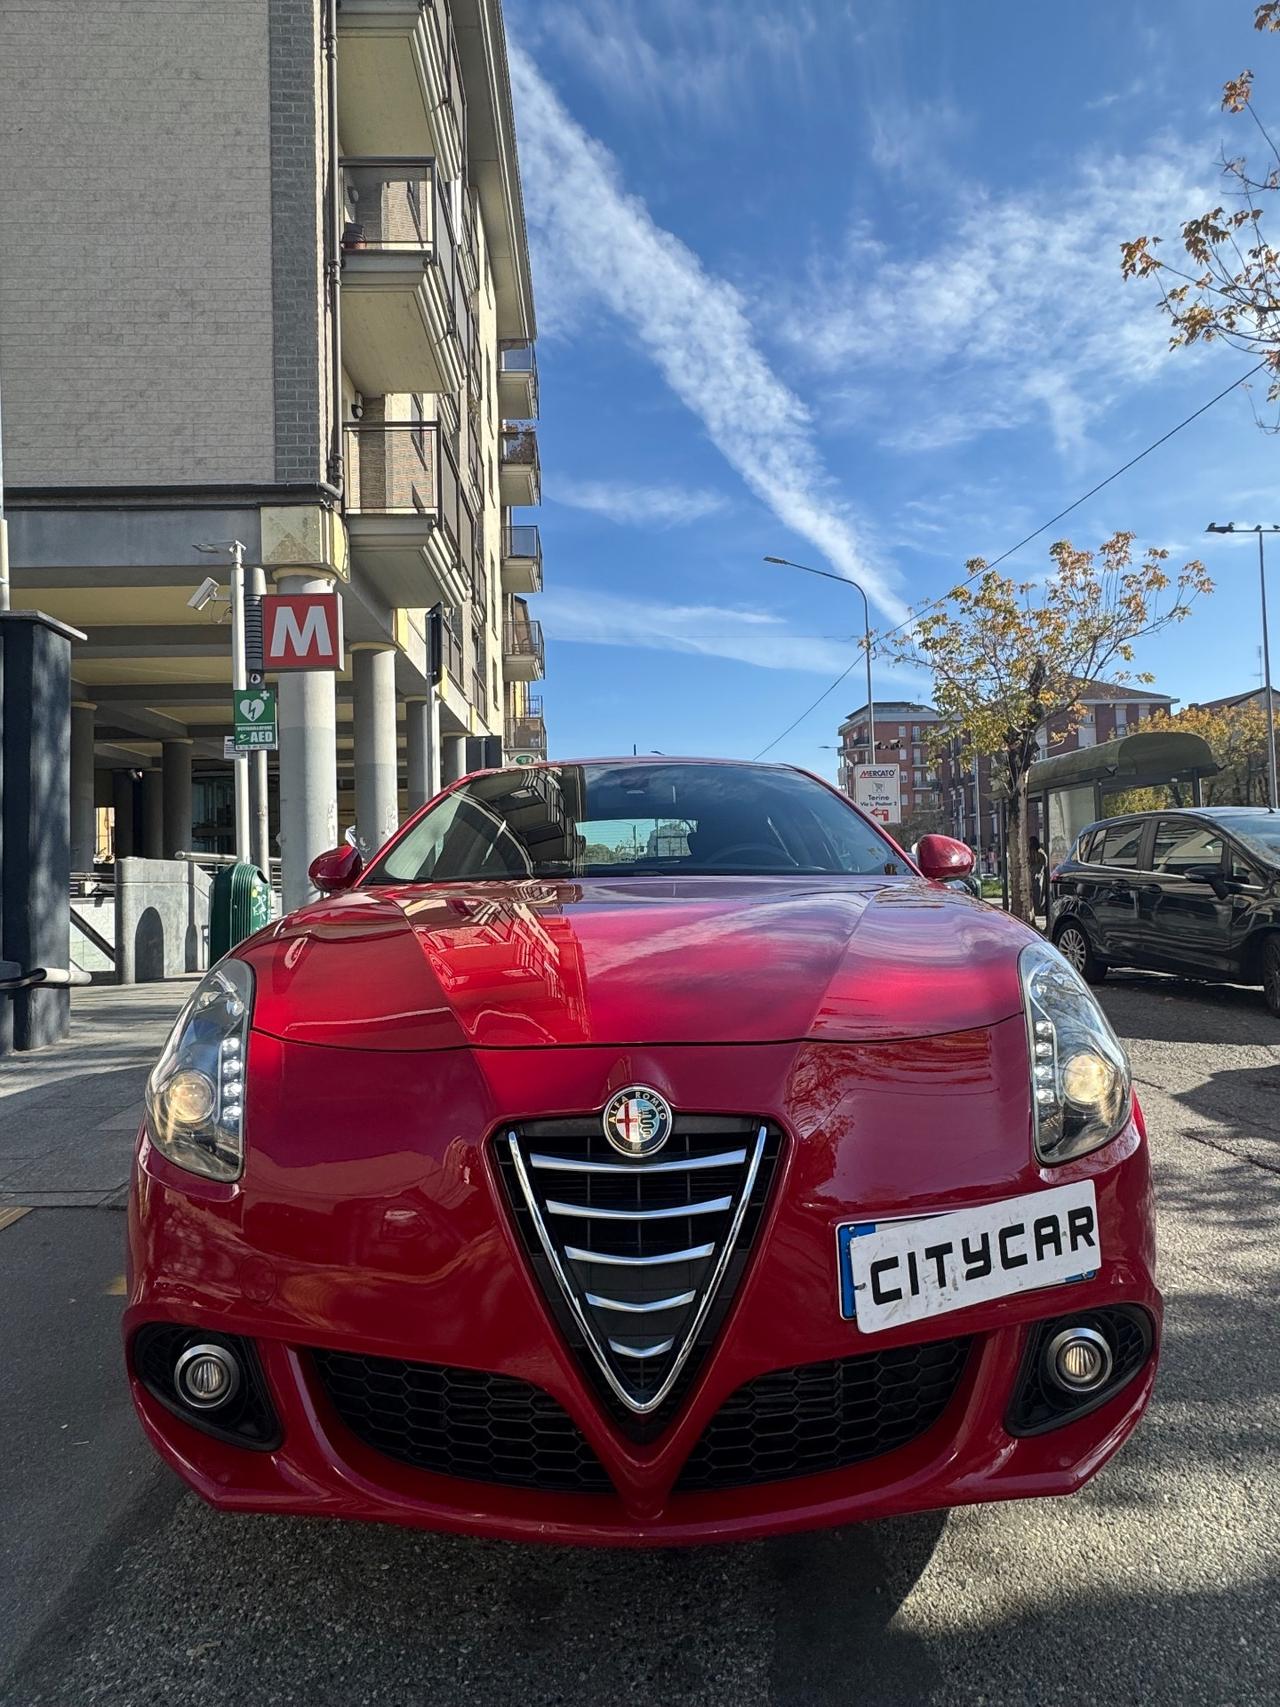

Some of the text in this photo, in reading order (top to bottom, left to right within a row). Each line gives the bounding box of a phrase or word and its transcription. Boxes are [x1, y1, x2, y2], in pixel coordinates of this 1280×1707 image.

[270, 605, 333, 657] M
[250, 731, 273, 743] AED
[608, 1091, 666, 1124] ALFA ROMEO
[870, 1206, 1095, 1305] CITYCAR
